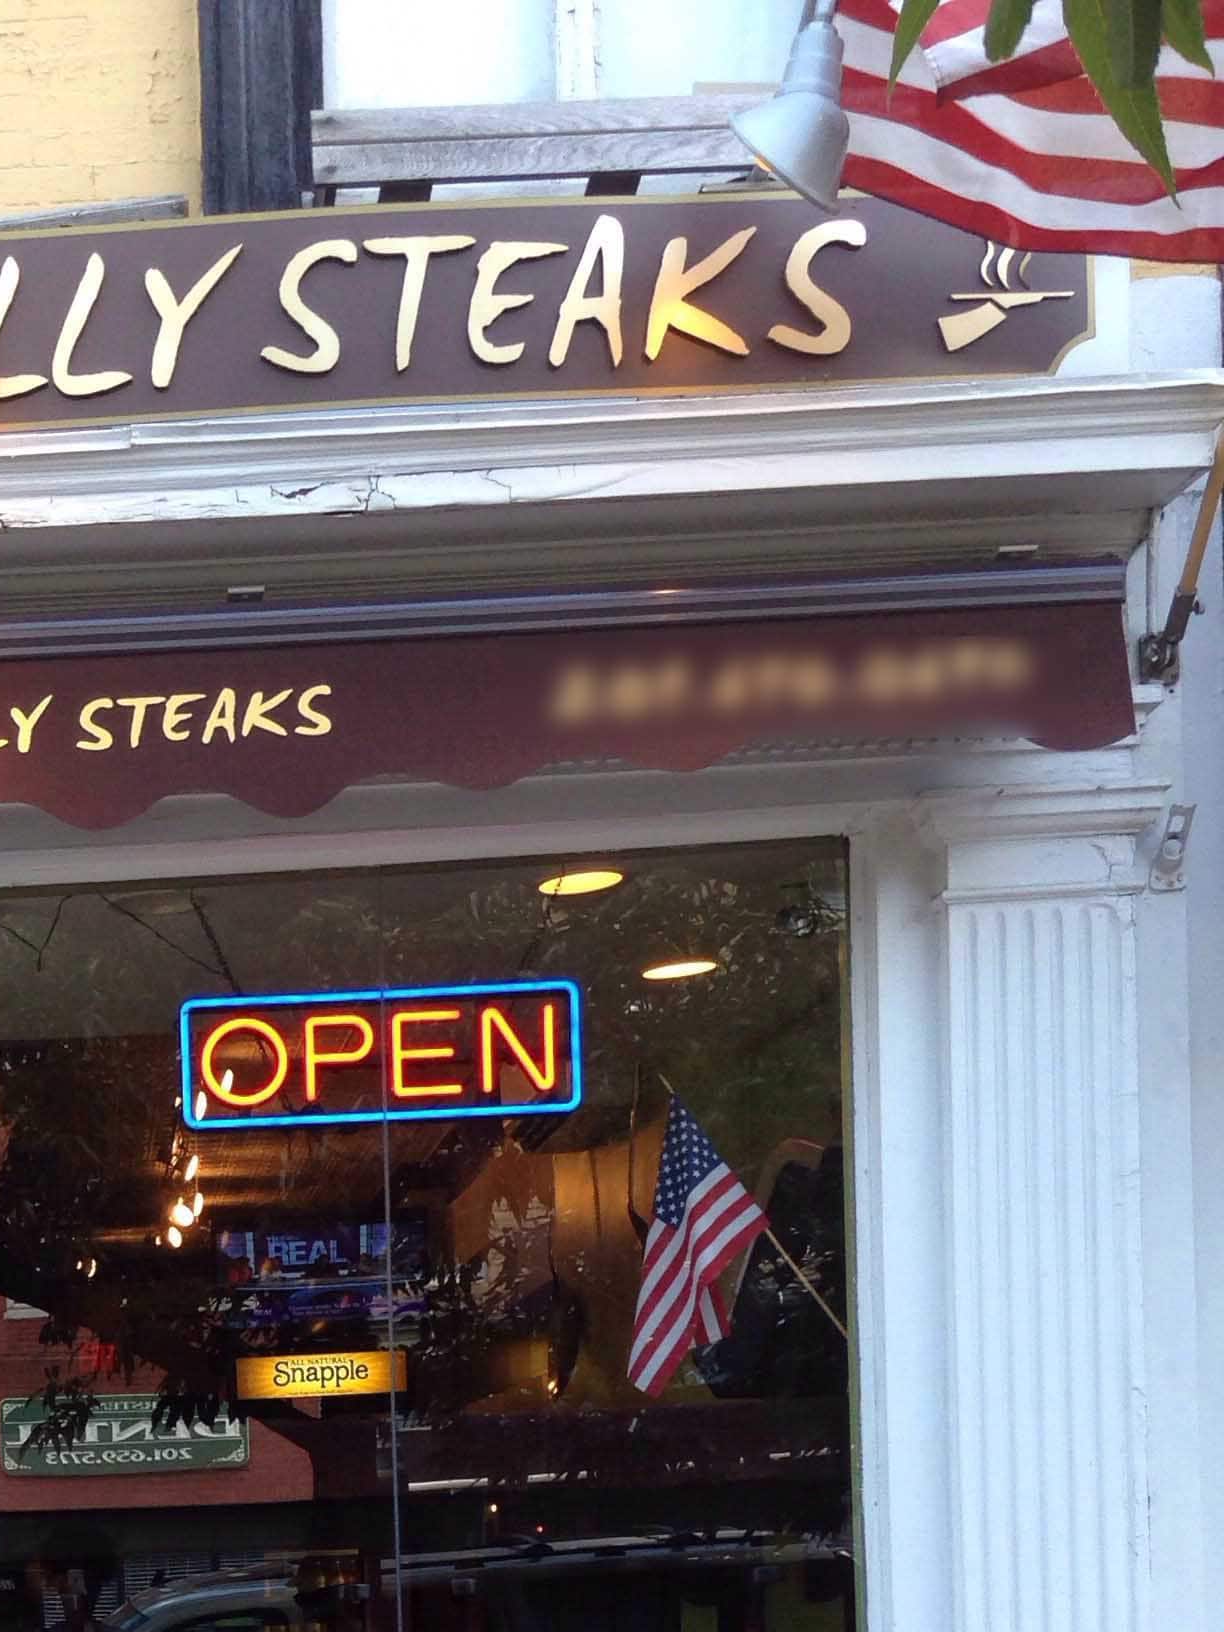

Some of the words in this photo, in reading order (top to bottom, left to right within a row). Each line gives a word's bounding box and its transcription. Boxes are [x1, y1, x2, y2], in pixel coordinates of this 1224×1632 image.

[261, 214, 868, 376] STEAKS
[76, 685, 333, 752] STEAKS
[200, 1003, 557, 1106] OPEN
[273, 1359, 369, 1388] Snapple
